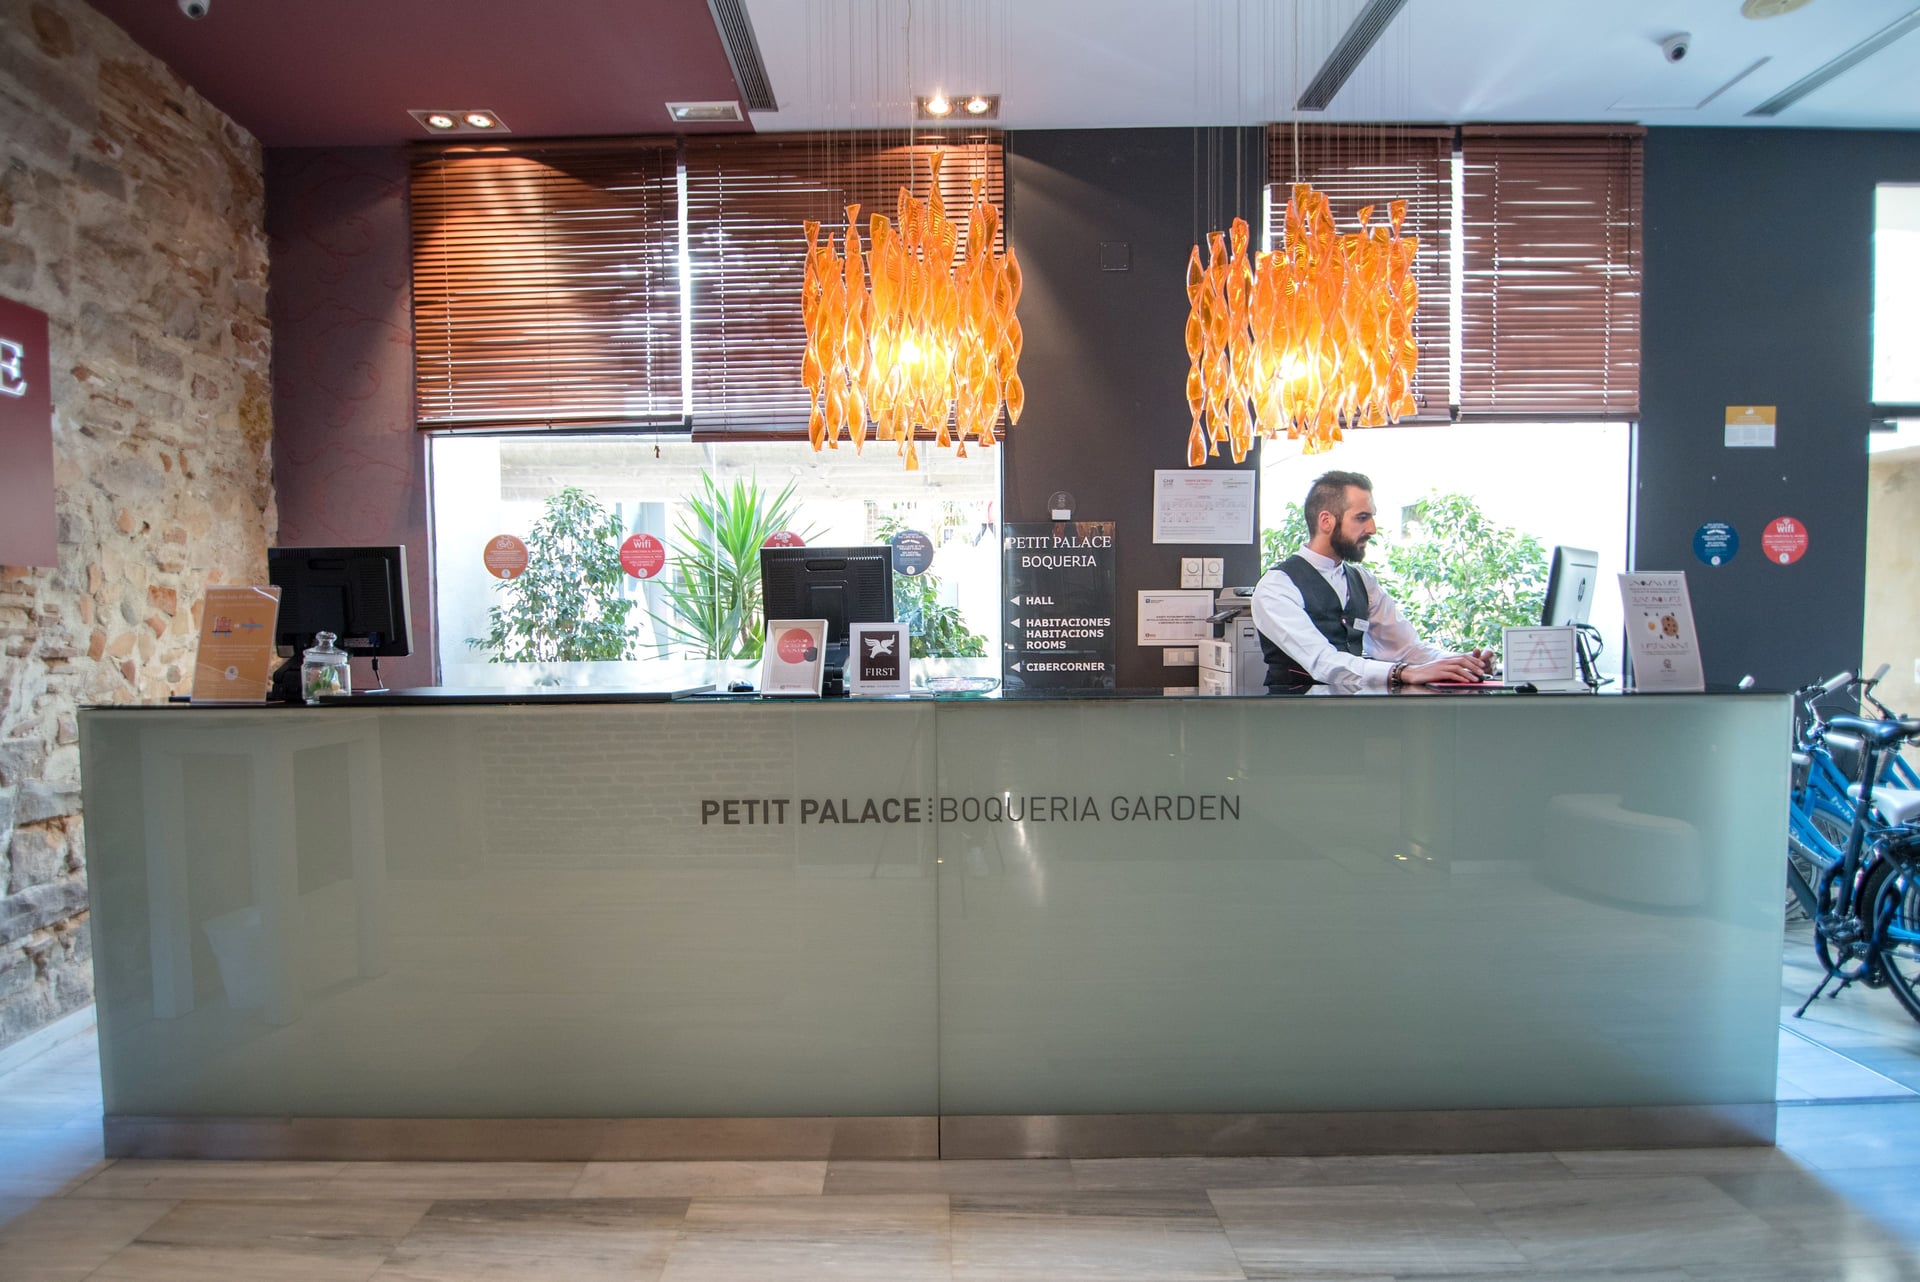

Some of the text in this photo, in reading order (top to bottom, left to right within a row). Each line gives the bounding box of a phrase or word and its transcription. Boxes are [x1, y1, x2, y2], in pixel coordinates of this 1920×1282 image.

[1009, 535, 1112, 549] PETIT PALACE
[1022, 555, 1097, 570] BOQUERIA
[1026, 596, 1055, 605] HALL
[1026, 618, 1111, 627] HABITACIONES
[1026, 629, 1104, 638] HABITACIONS
[1026, 641, 1067, 650] ROOMS
[865, 667, 896, 677] FIRST
[1026, 662, 1105, 672] CIBERCORNER
[701, 795, 1241, 825] PETIT PALACE BOQUERIA GARDEN
